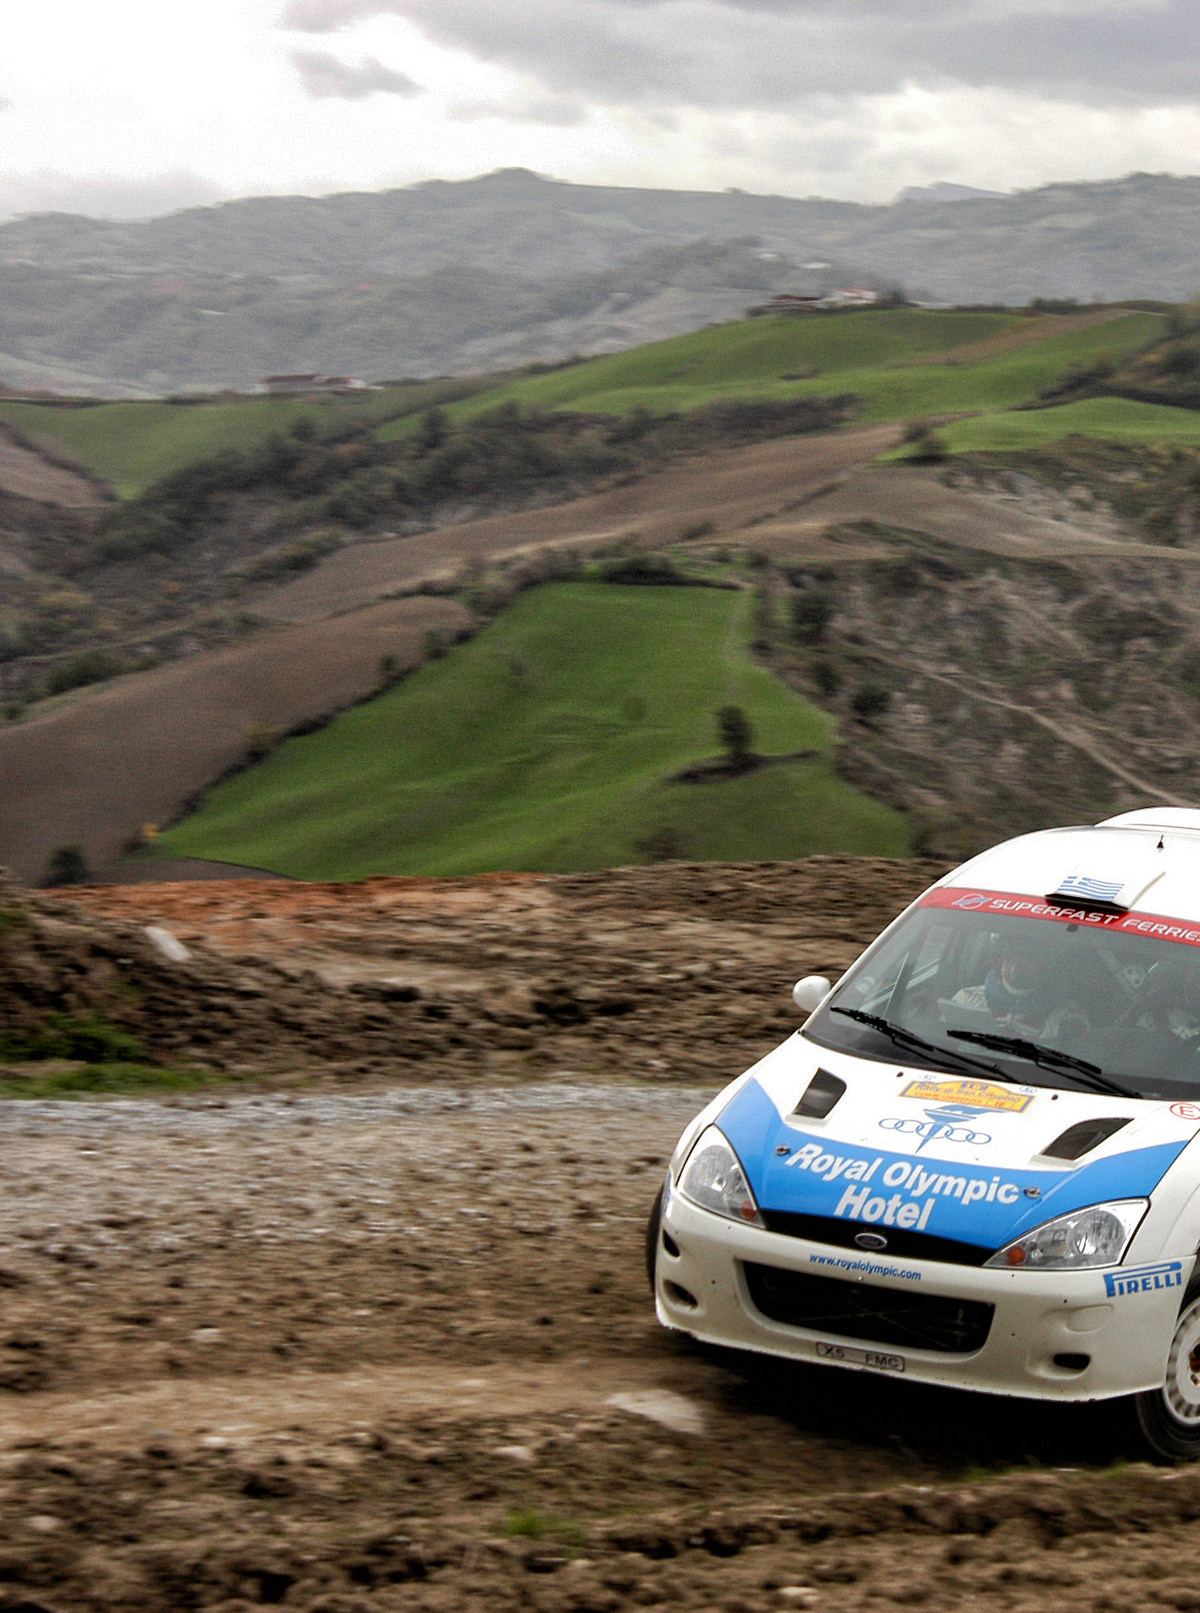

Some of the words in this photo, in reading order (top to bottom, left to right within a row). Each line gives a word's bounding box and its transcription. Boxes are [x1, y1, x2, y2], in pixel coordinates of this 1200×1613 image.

[988, 898, 1119, 926] SUPERFAST
[785, 1143, 884, 1182] Royal
[882, 1161, 1020, 1205] Olympic
[833, 1184, 936, 1231] Hotel
[809, 1253, 922, 1281] www.royalolympic.com
[1103, 1262, 1182, 1298] PIRELLI
[865, 1353, 899, 1369] FMC
